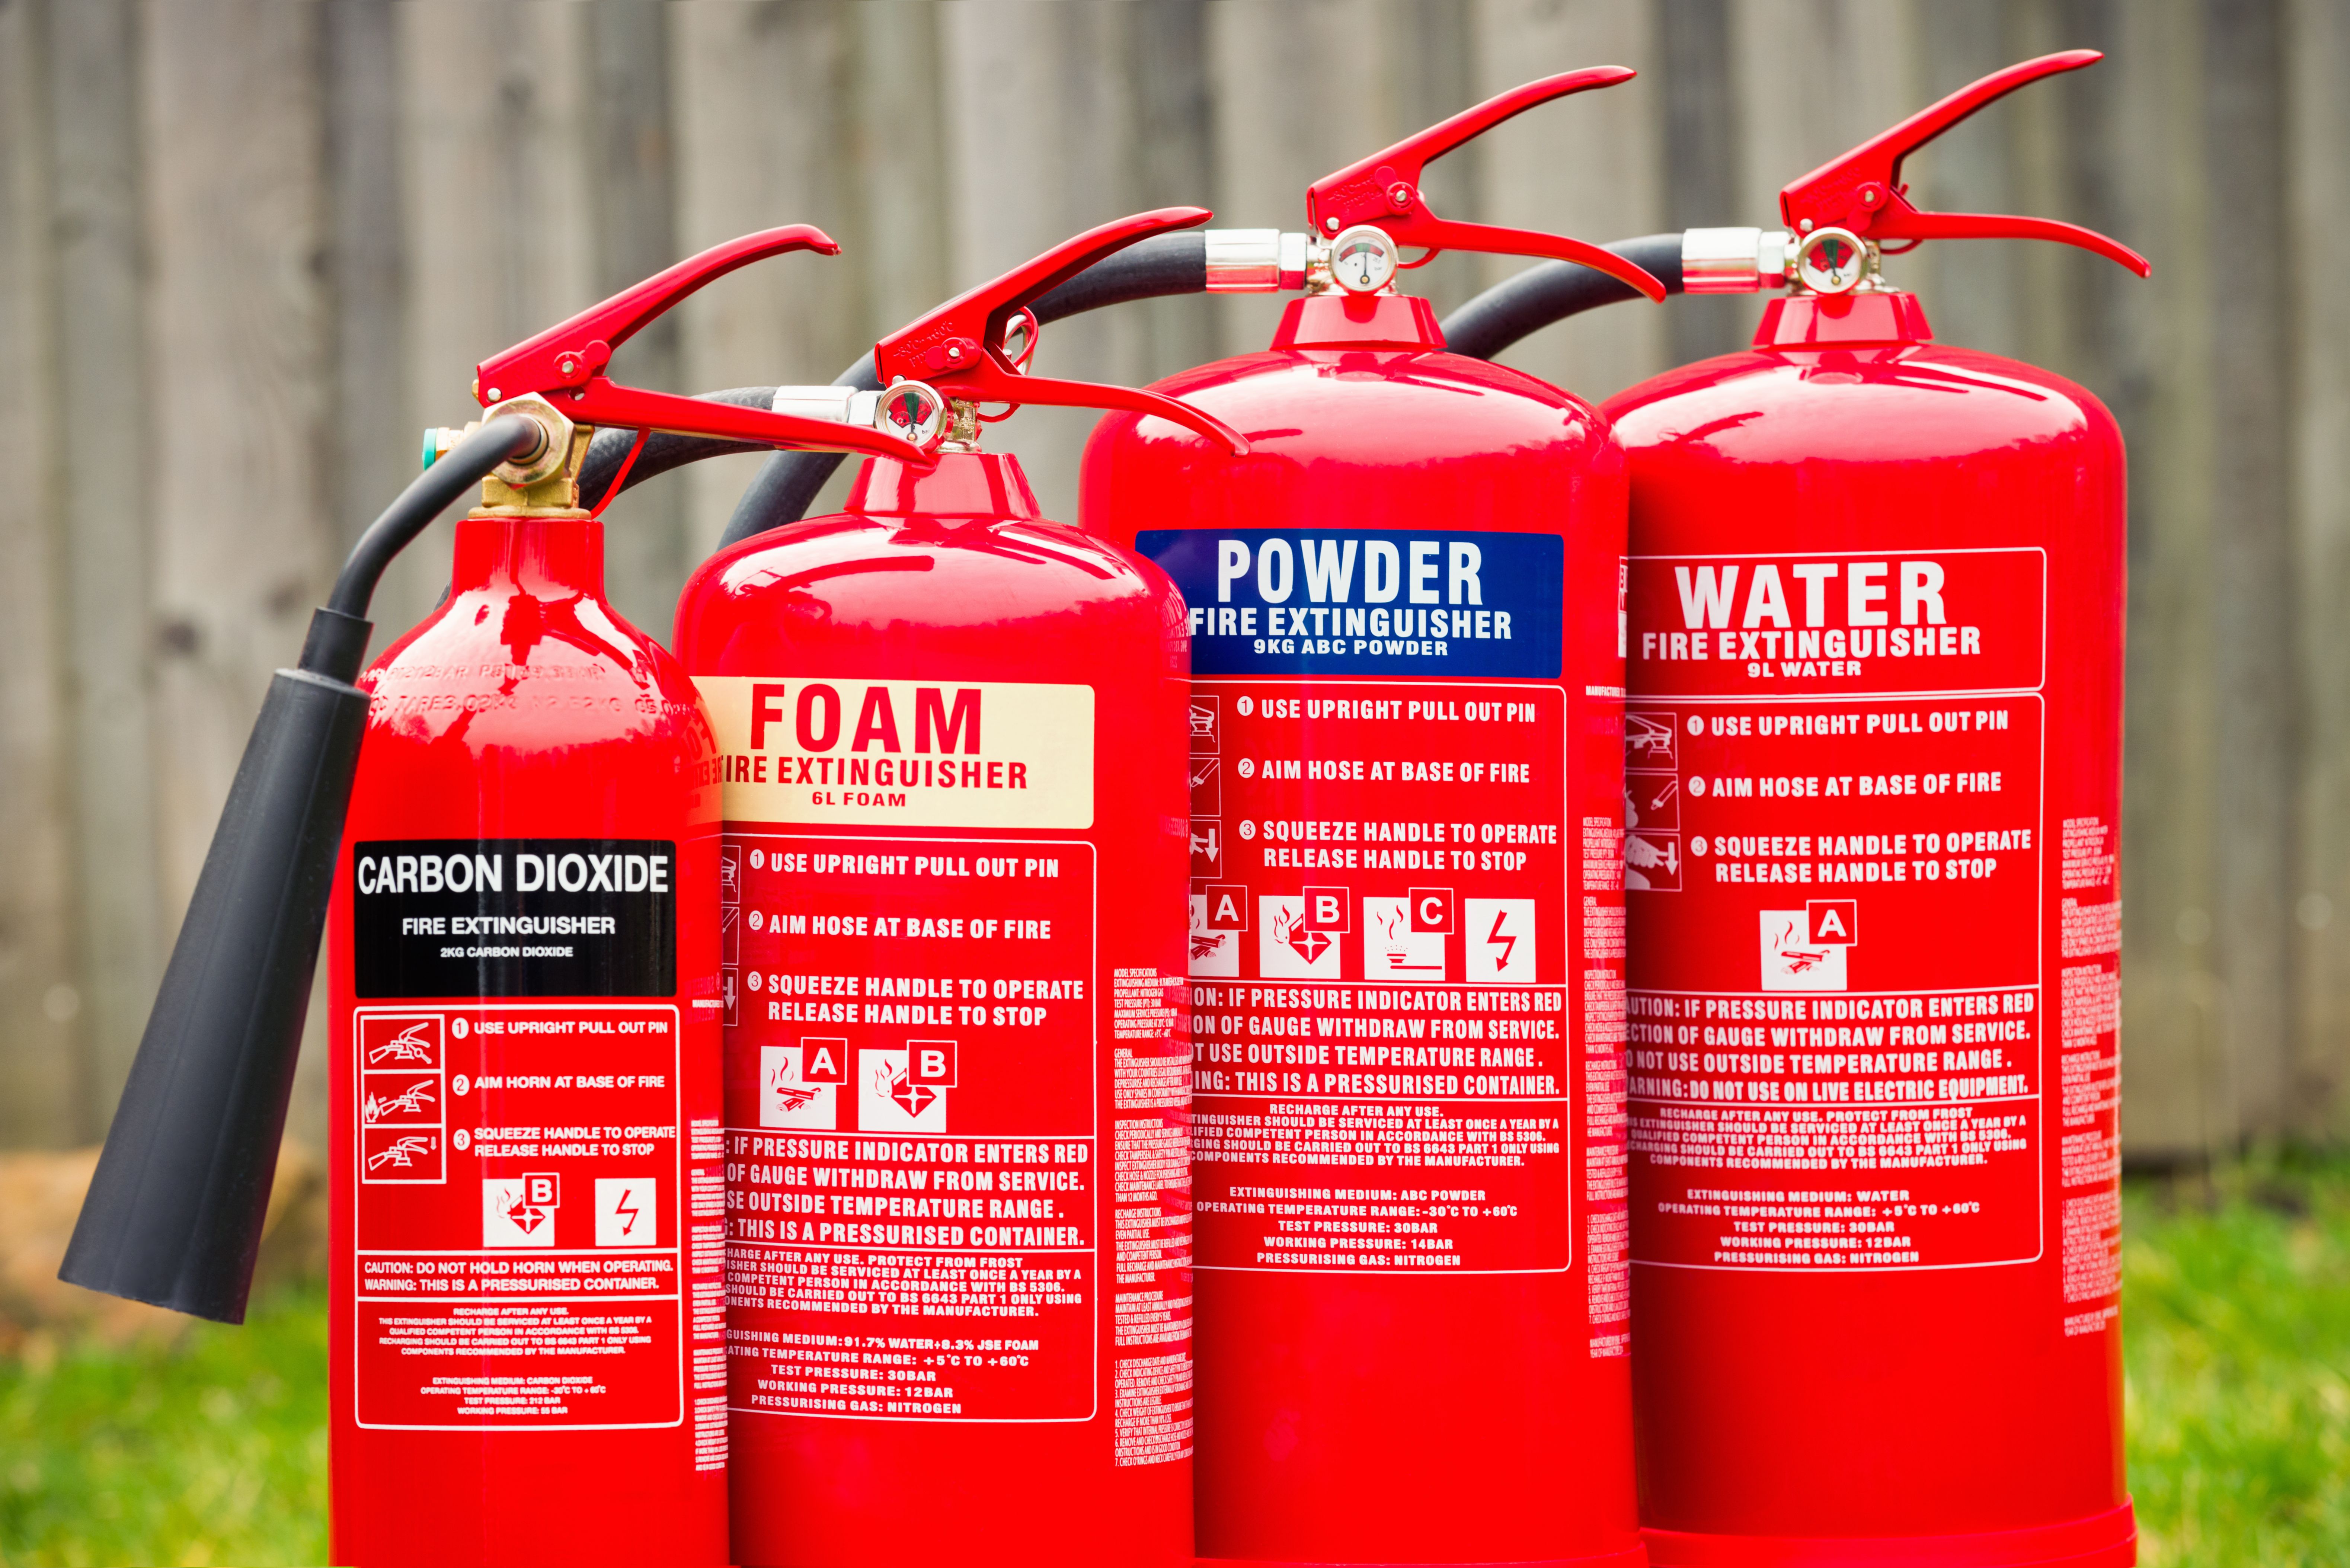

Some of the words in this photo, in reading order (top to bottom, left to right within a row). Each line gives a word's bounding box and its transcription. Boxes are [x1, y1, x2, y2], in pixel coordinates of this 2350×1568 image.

[1218, 538, 1483, 605] POWDER
[1675, 561, 1946, 628] WATER
[1189, 608, 1257, 636] FIRE
[1269, 608, 1511, 639] EXTINGUISHER
[1254, 639, 1294, 654] 9KG
[1301, 639, 1346, 654] ABC
[1354, 640, 1448, 655] POWDER
[1644, 633, 1707, 659] FIRE
[1719, 627, 1980, 659] EXTINGUISHER
[1748, 663, 1774, 677] 9L
[1781, 661, 1861, 677] WATER
[751, 684, 981, 754] FOAM
[1262, 699, 1300, 718] USE
[1308, 700, 1402, 719] UPRIGHT
[1409, 701, 1459, 720] PULL
[1465, 702, 1502, 721] OUT
[1507, 703, 1535, 722] PIN
[721, 755, 767, 783] IRE
[778, 757, 1026, 788] EXTINGUISHER
[1713, 778, 1752, 797] AIM
[1760, 777, 1818, 797] HOSE
[1825, 777, 1852, 796] AT
[1860, 775, 1916, 795] BASE
[1924, 774, 1950, 794] OF
[1957, 772, 2001, 793] FIRE
[813, 792, 835, 805] 6L
[844, 793, 905, 806] FOAM
[1715, 837, 1811, 858] SQUEEZE
[1819, 835, 1906, 855] HANDLE
[1913, 833, 1940, 853] TO
[1947, 829, 2031, 852] OPERATE
[358, 854, 502, 894] CARBON
[517, 854, 668, 892] DIOXIDE
[1716, 863, 1811, 883] RELEASE
[1819, 862, 1906, 882] HANDLE
[1912, 860, 1939, 880] TO
[1946, 858, 1996, 879] STOP
[1215, 895, 1238, 921] A
[1316, 896, 1339, 923] B
[1420, 897, 1443, 925] C
[403, 918, 445, 935] FIRE
[452, 916, 615, 934] EXTINGUISHER
[1818, 910, 1846, 937] A
[441, 947, 464, 957] 2KG
[467, 947, 519, 957] CARBON
[522, 946, 573, 957] DIOXIDE
[1114, 969, 1129, 977] MODEL
[1129, 968, 1157, 977] SPECIFICATIONS
[769, 975, 858, 996] SQUEEZE
[866, 977, 953, 998] HANDLE
[959, 979, 987, 998] TO
[994, 980, 1083, 999] OPERATE
[1114, 988, 1140, 998] PROPELLANT:
[1140, 988, 1158, 997] NITROGEN
[769, 1002, 858, 1022] RELEASE
[865, 1004, 952, 1024] HANDLE
[959, 1007, 986, 1025] TO
[993, 1007, 1046, 1026] STOP
[1114, 999, 1124, 1008] TEST
[1124, 998, 1142, 1008] PRESSURE
[1685, 1000, 1700, 1017] IF
[1706, 1000, 1806, 1020] PRESSURE
[1813, 999, 1922, 1020] INDICATOR
[1929, 995, 1998, 1017] ENTERS
[2003, 993, 2033, 1013] RED
[474, 1022, 504, 1034] USE
[508, 1021, 575, 1034] UPRIGHT
[579, 1022, 615, 1033] PULL
[618, 1022, 646, 1033] OUT
[648, 1022, 667, 1033] PIN
[810, 1048, 837, 1074] A
[921, 1050, 946, 1077] B
[474, 1076, 502, 1089] AIM
[506, 1076, 551, 1088] HORN
[554, 1076, 573, 1088] AT
[576, 1076, 614, 1088] BASE
[617, 1076, 635, 1088] OF
[639, 1076, 665, 1087] FIRE
[1235, 1072, 1277, 1091] THIS
[1283, 1073, 1301, 1092] IS
[1307, 1073, 1318, 1092] A
[1325, 1074, 1458, 1094] PRESSURISED
[1464, 1075, 1559, 1095] CONTAINER.
[1270, 1104, 1338, 1115] RECHARGE
[1342, 1105, 1383, 1116] AFTER
[1387, 1106, 1411, 1116] ANY
[1416, 1106, 1443, 1117] USE.
[735, 1137, 748, 1154] IF
[754, 1137, 848, 1159] PRESSURE
[855, 1141, 968, 1162] INDICATOR
[975, 1144, 1049, 1163] ENTERS
[1055, 1144, 1087, 1163] RED
[728, 1164, 745, 1181] OF
[751, 1165, 807, 1185] GAUGE
[813, 1168, 927, 1189] WITHDRAW
[934, 1171, 992, 1190] FROM
[999, 1171, 1084, 1191] SERVICE.
[532, 1179, 552, 1202] B
[1230, 1187, 1330, 1199] EXTINGUISHING
[1335, 1189, 1397, 1200] MEDIUM:
[1401, 1190, 1427, 1200] ABC
[1431, 1190, 1485, 1200] POWDER
[1688, 1190, 1784, 1202] EXTINGUISHING
[1788, 1191, 1851, 1202] MEDIUM:
[1857, 1190, 1909, 1201] WATER
[1734, 1222, 1765, 1232] TEST
[1769, 1222, 1845, 1233] PRESSURE:
[1849, 1222, 1894, 1233] 30BAR
[1264, 1237, 1326, 1248] WORKING
[1330, 1238, 1406, 1249] PRESSURE:
[1411, 1239, 1453, 1249] 14BAR
[365, 1262, 413, 1273] CAUTION:
[417, 1262, 435, 1274] DO
[438, 1262, 466, 1274] NOT
[470, 1262, 509, 1274] HOLD
[513, 1262, 554, 1274] HORN
[558, 1261, 600, 1273] WHEN
[603, 1260, 673, 1273] OPERATING.
[365, 1279, 416, 1290] WARNING:
[419, 1279, 448, 1291] THIS
[452, 1279, 465, 1291] IS
[468, 1279, 478, 1291] A
[481, 1278, 581, 1291] PRESSURISED
[584, 1277, 659, 1290] CONTAINER.
[771, 1365, 801, 1375] TEST
[805, 1367, 883, 1380] PRESSURE:
[888, 1370, 936, 1381] 30BAR
[758, 1380, 816, 1392] WORKING
[821, 1383, 900, 1396] PRESSURE:
[905, 1387, 953, 1398] 12BAR
[752, 1395, 845, 1410] PRESSURISING
[850, 1401, 883, 1411] GAS:
[888, 1402, 961, 1413] NITROGEN
